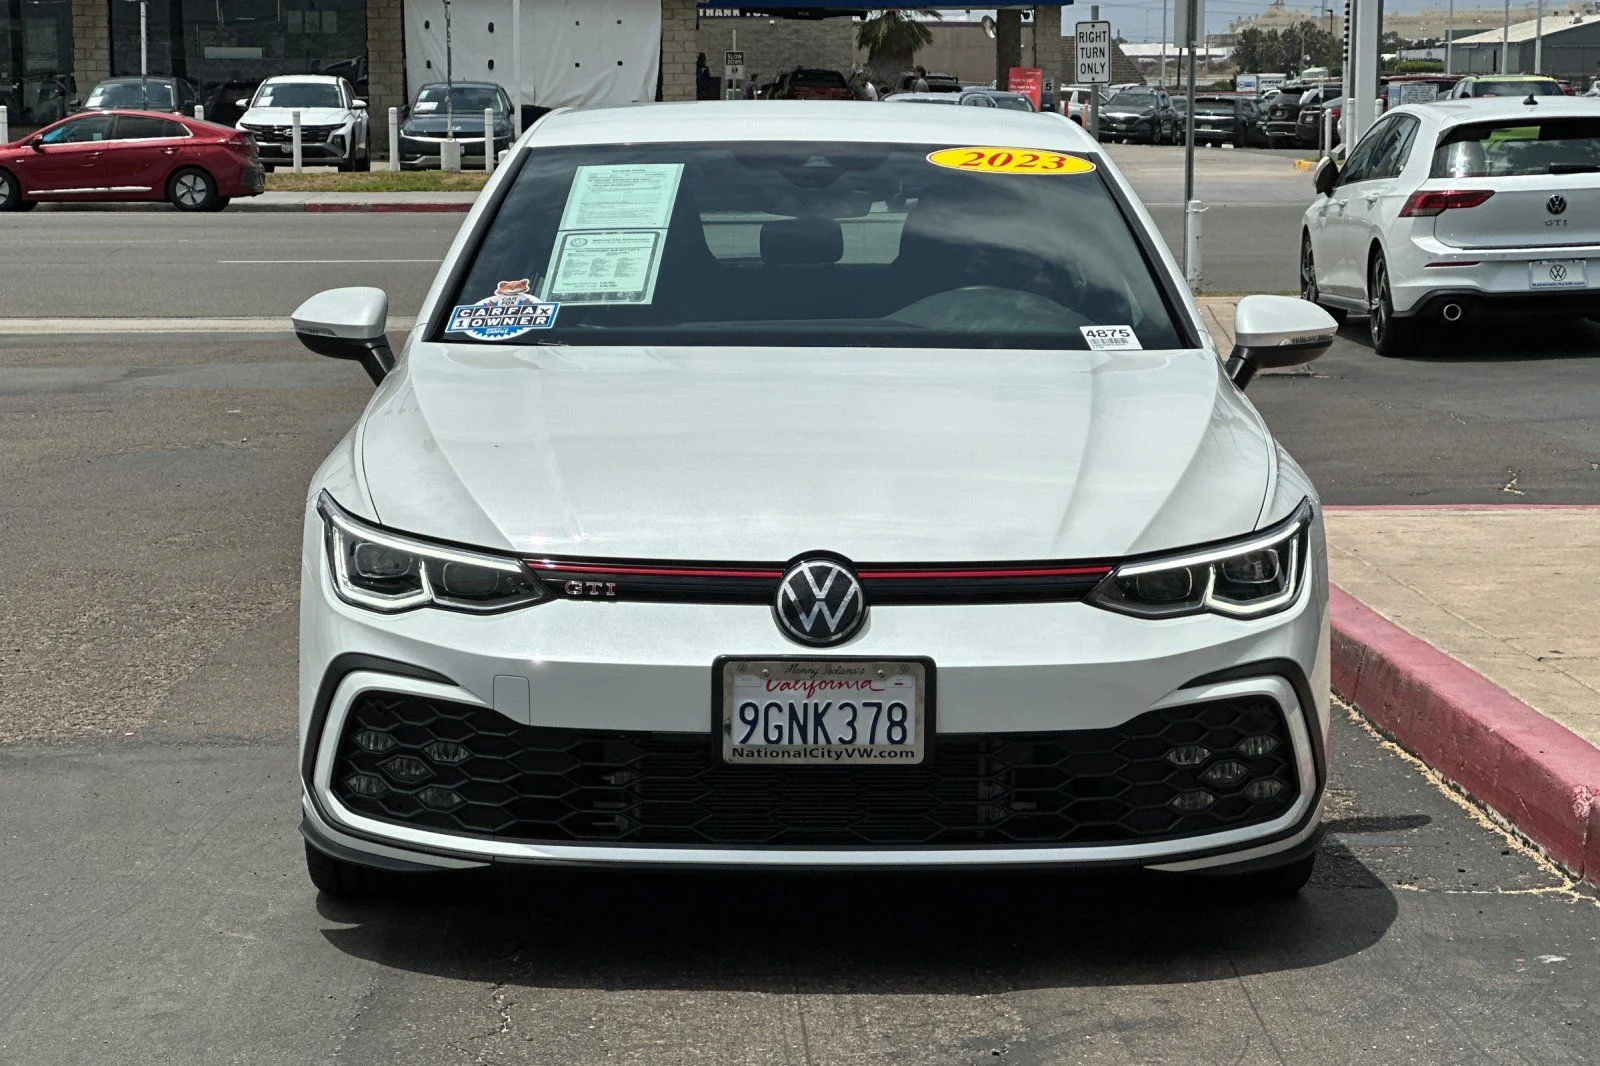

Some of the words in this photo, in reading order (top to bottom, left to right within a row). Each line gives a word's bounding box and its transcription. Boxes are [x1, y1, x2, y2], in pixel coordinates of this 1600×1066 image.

[699, 8, 740, 17] THANK
[1079, 31, 1107, 43] RIGHT
[1080, 47, 1105, 59] TURN
[1081, 62, 1106, 75] ONLY
[959, 151, 1067, 170] 2023
[459, 306, 551, 317] CARFAX
[470, 316, 547, 327] OWNER
[1086, 329, 1130, 338] 4875
[564, 580, 616, 596] GTI
[783, 663, 819, 680] Manny
[738, 701, 908, 745] 9GNK378
[732, 747, 915, 759] NationalCityVW.com
